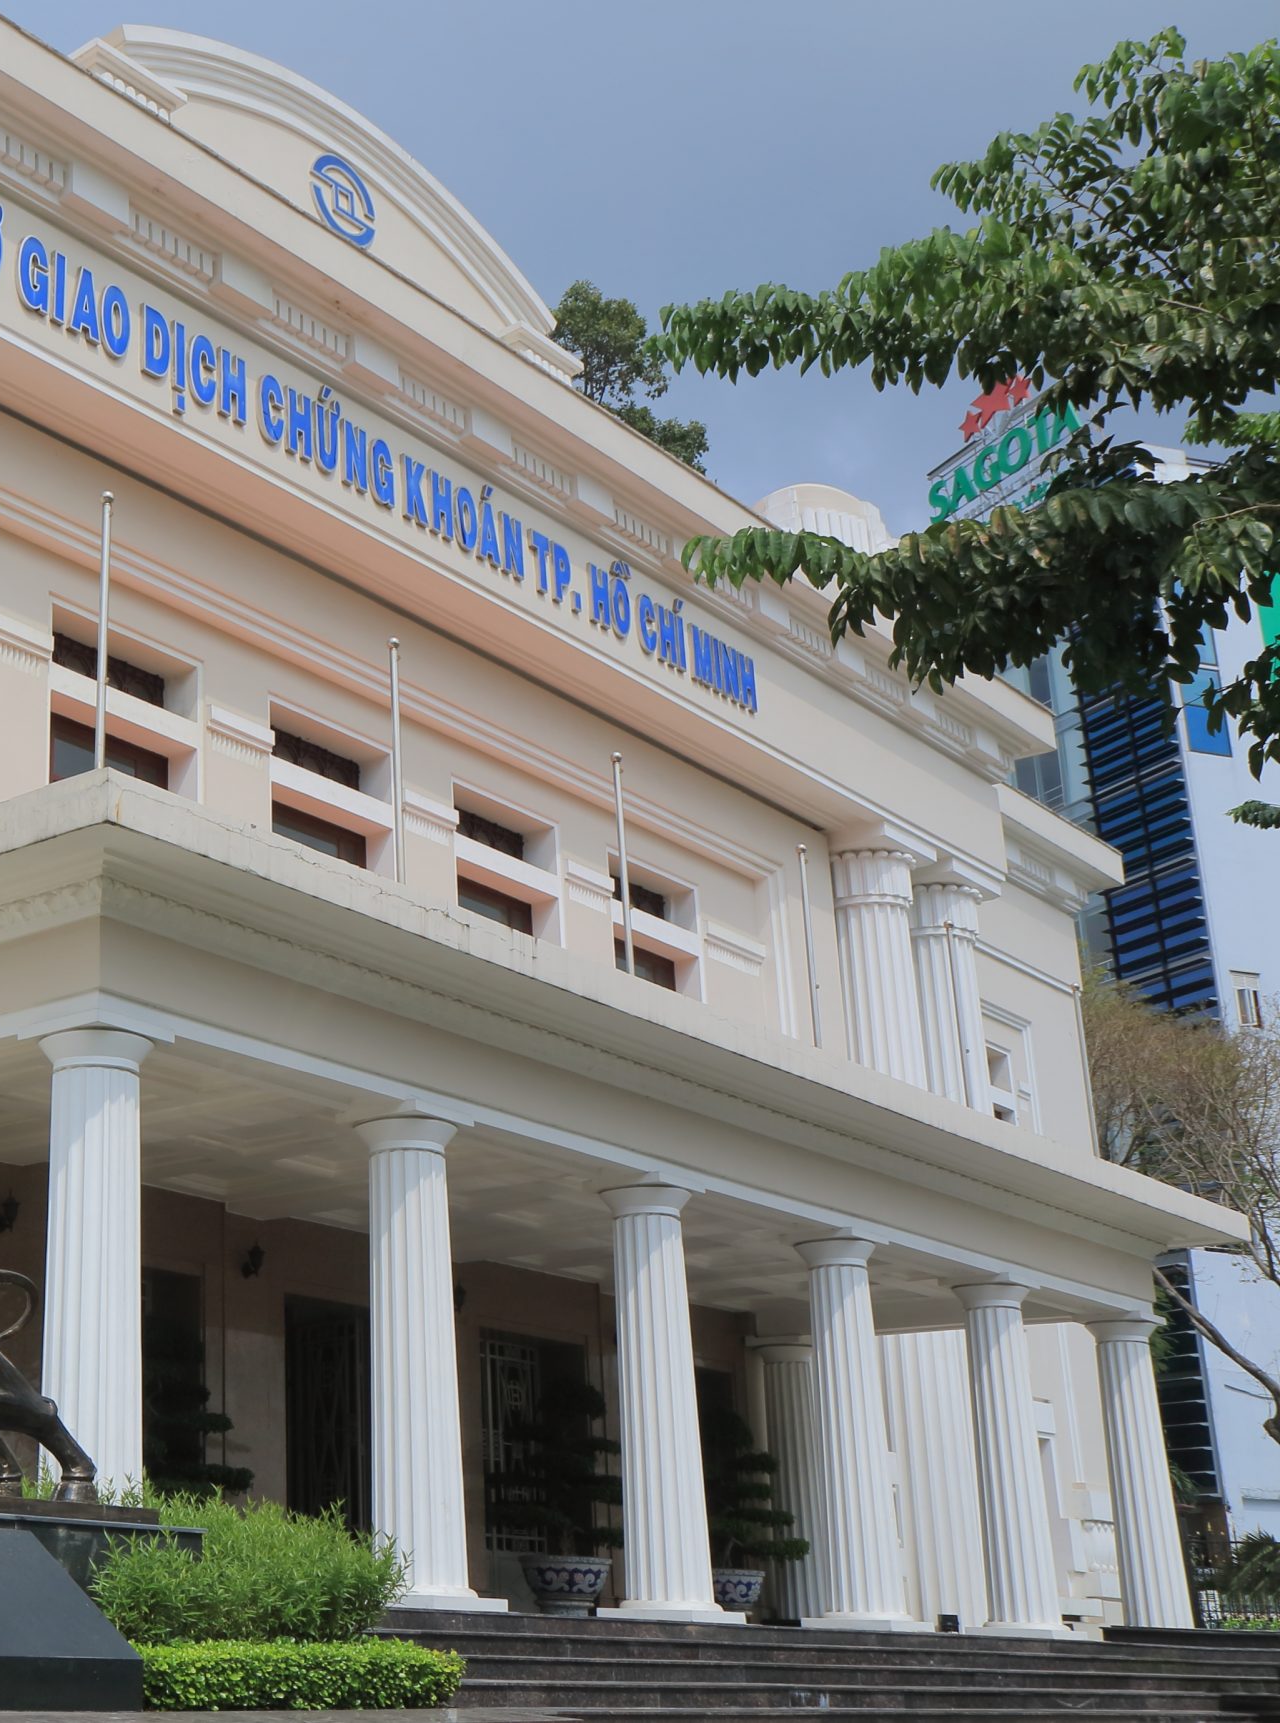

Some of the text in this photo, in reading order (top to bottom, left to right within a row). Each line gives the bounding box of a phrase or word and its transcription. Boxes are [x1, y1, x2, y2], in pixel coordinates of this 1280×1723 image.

[17, 235, 131, 358] GIAO
[140, 302, 247, 427] DỊCH
[258, 374, 396, 510] CHỨNG
[400, 452, 525, 581] KHOÁN
[527, 528, 582, 615] TP.
[586, 560, 632, 640] HỒ
[635, 592, 688, 673] CHÍ
[688, 622, 759, 714] MINH
[928, 399, 1083, 524] SAGOTA
